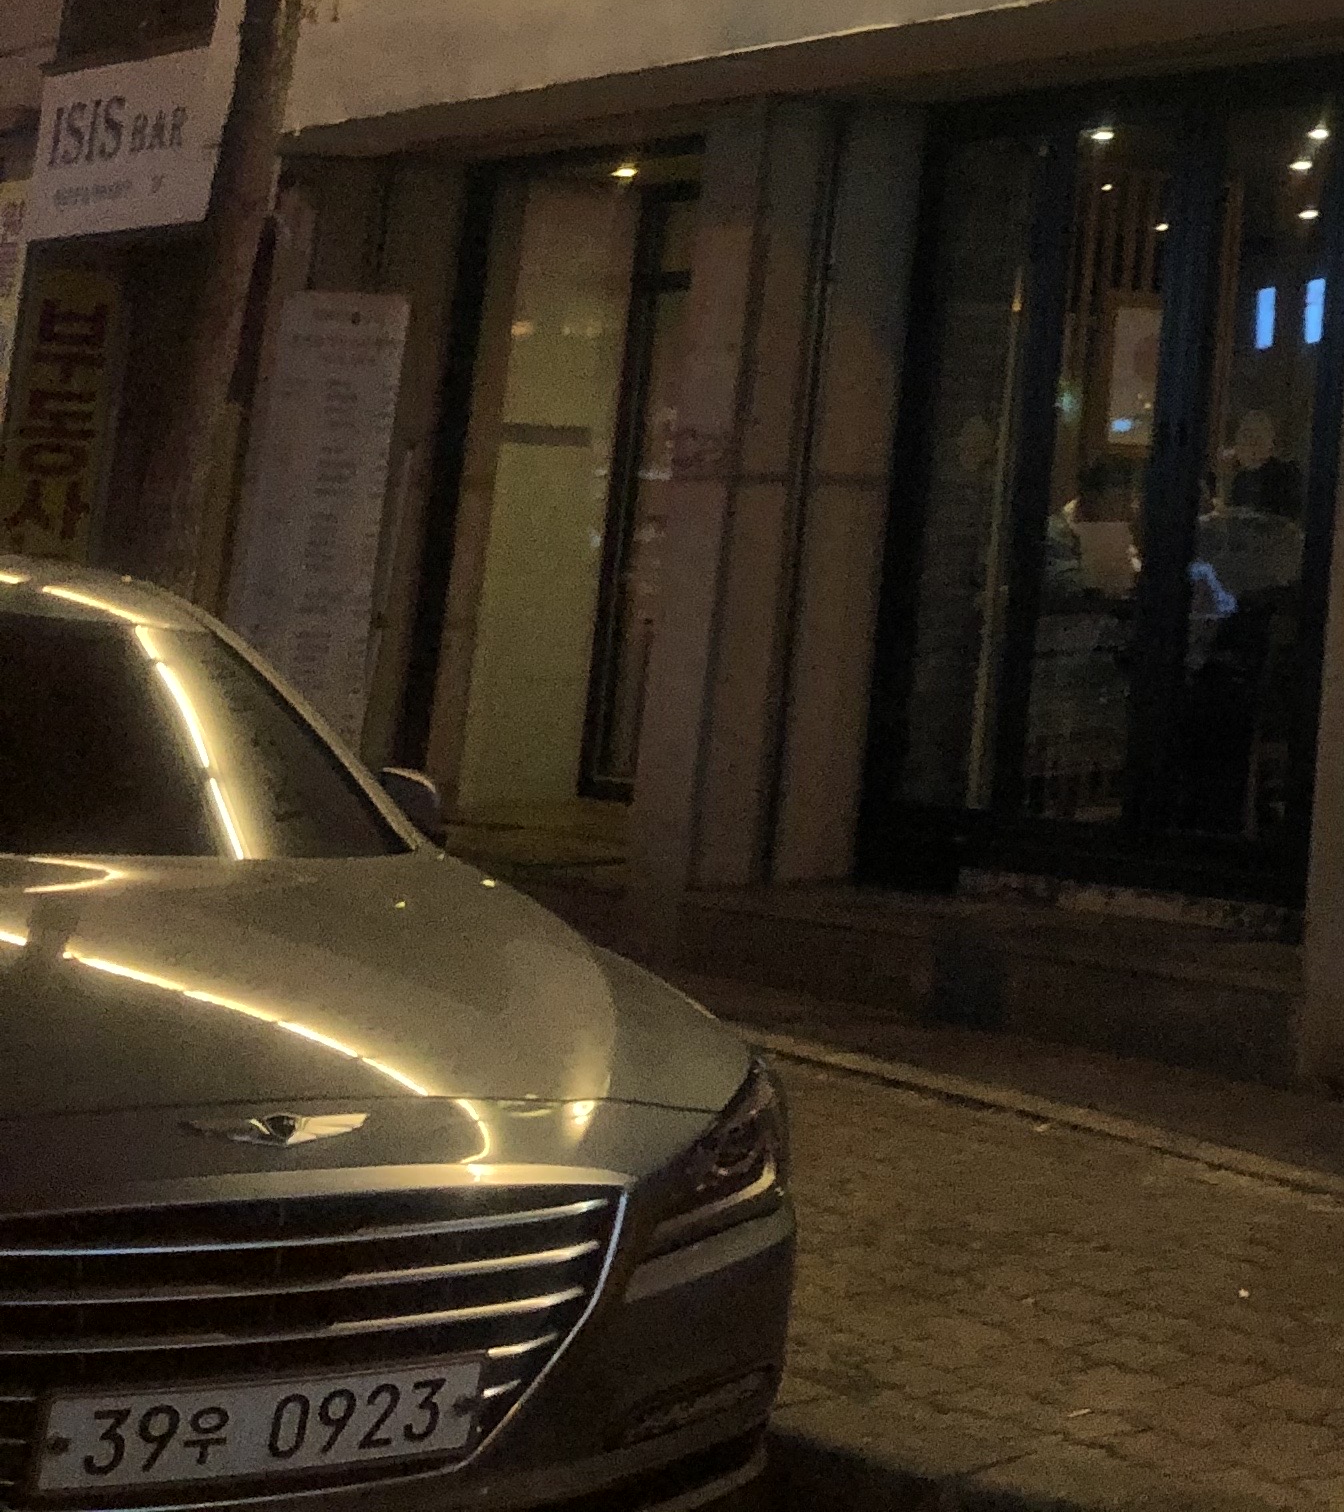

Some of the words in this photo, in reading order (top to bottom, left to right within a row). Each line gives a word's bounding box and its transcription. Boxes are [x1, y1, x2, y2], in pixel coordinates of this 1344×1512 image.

[48, 95, 126, 166] ISIS
[128, 106, 187, 153] BAR
[82, 1403, 232, 1477] 39우
[266, 1377, 447, 1460] 0923
